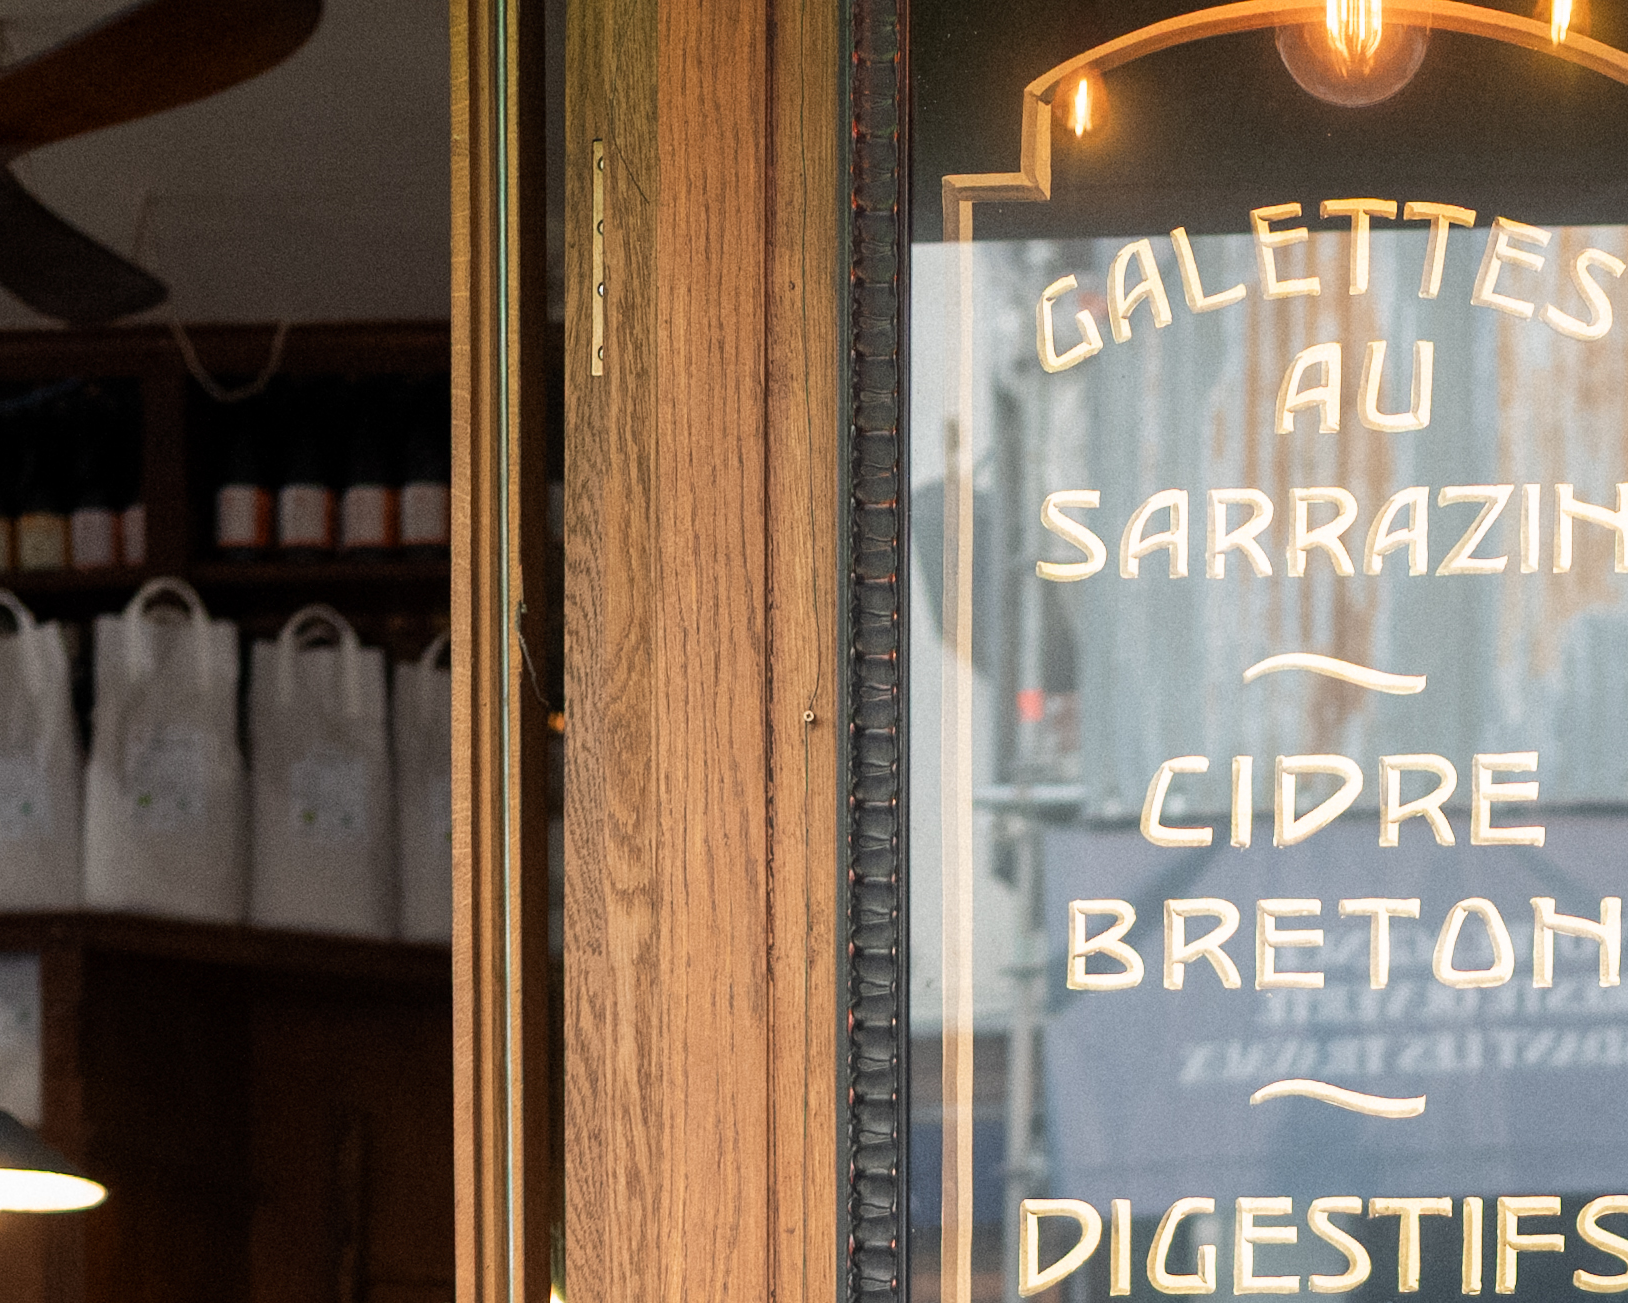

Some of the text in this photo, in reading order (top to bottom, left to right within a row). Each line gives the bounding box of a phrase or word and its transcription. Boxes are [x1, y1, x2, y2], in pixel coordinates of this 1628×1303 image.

[1036, 197, 1626, 374] GALETTES
[1274, 339, 1434, 434] AU
[1139, 749, 1546, 849] CIDRE
[1065, 896, 1624, 991] BRETON
